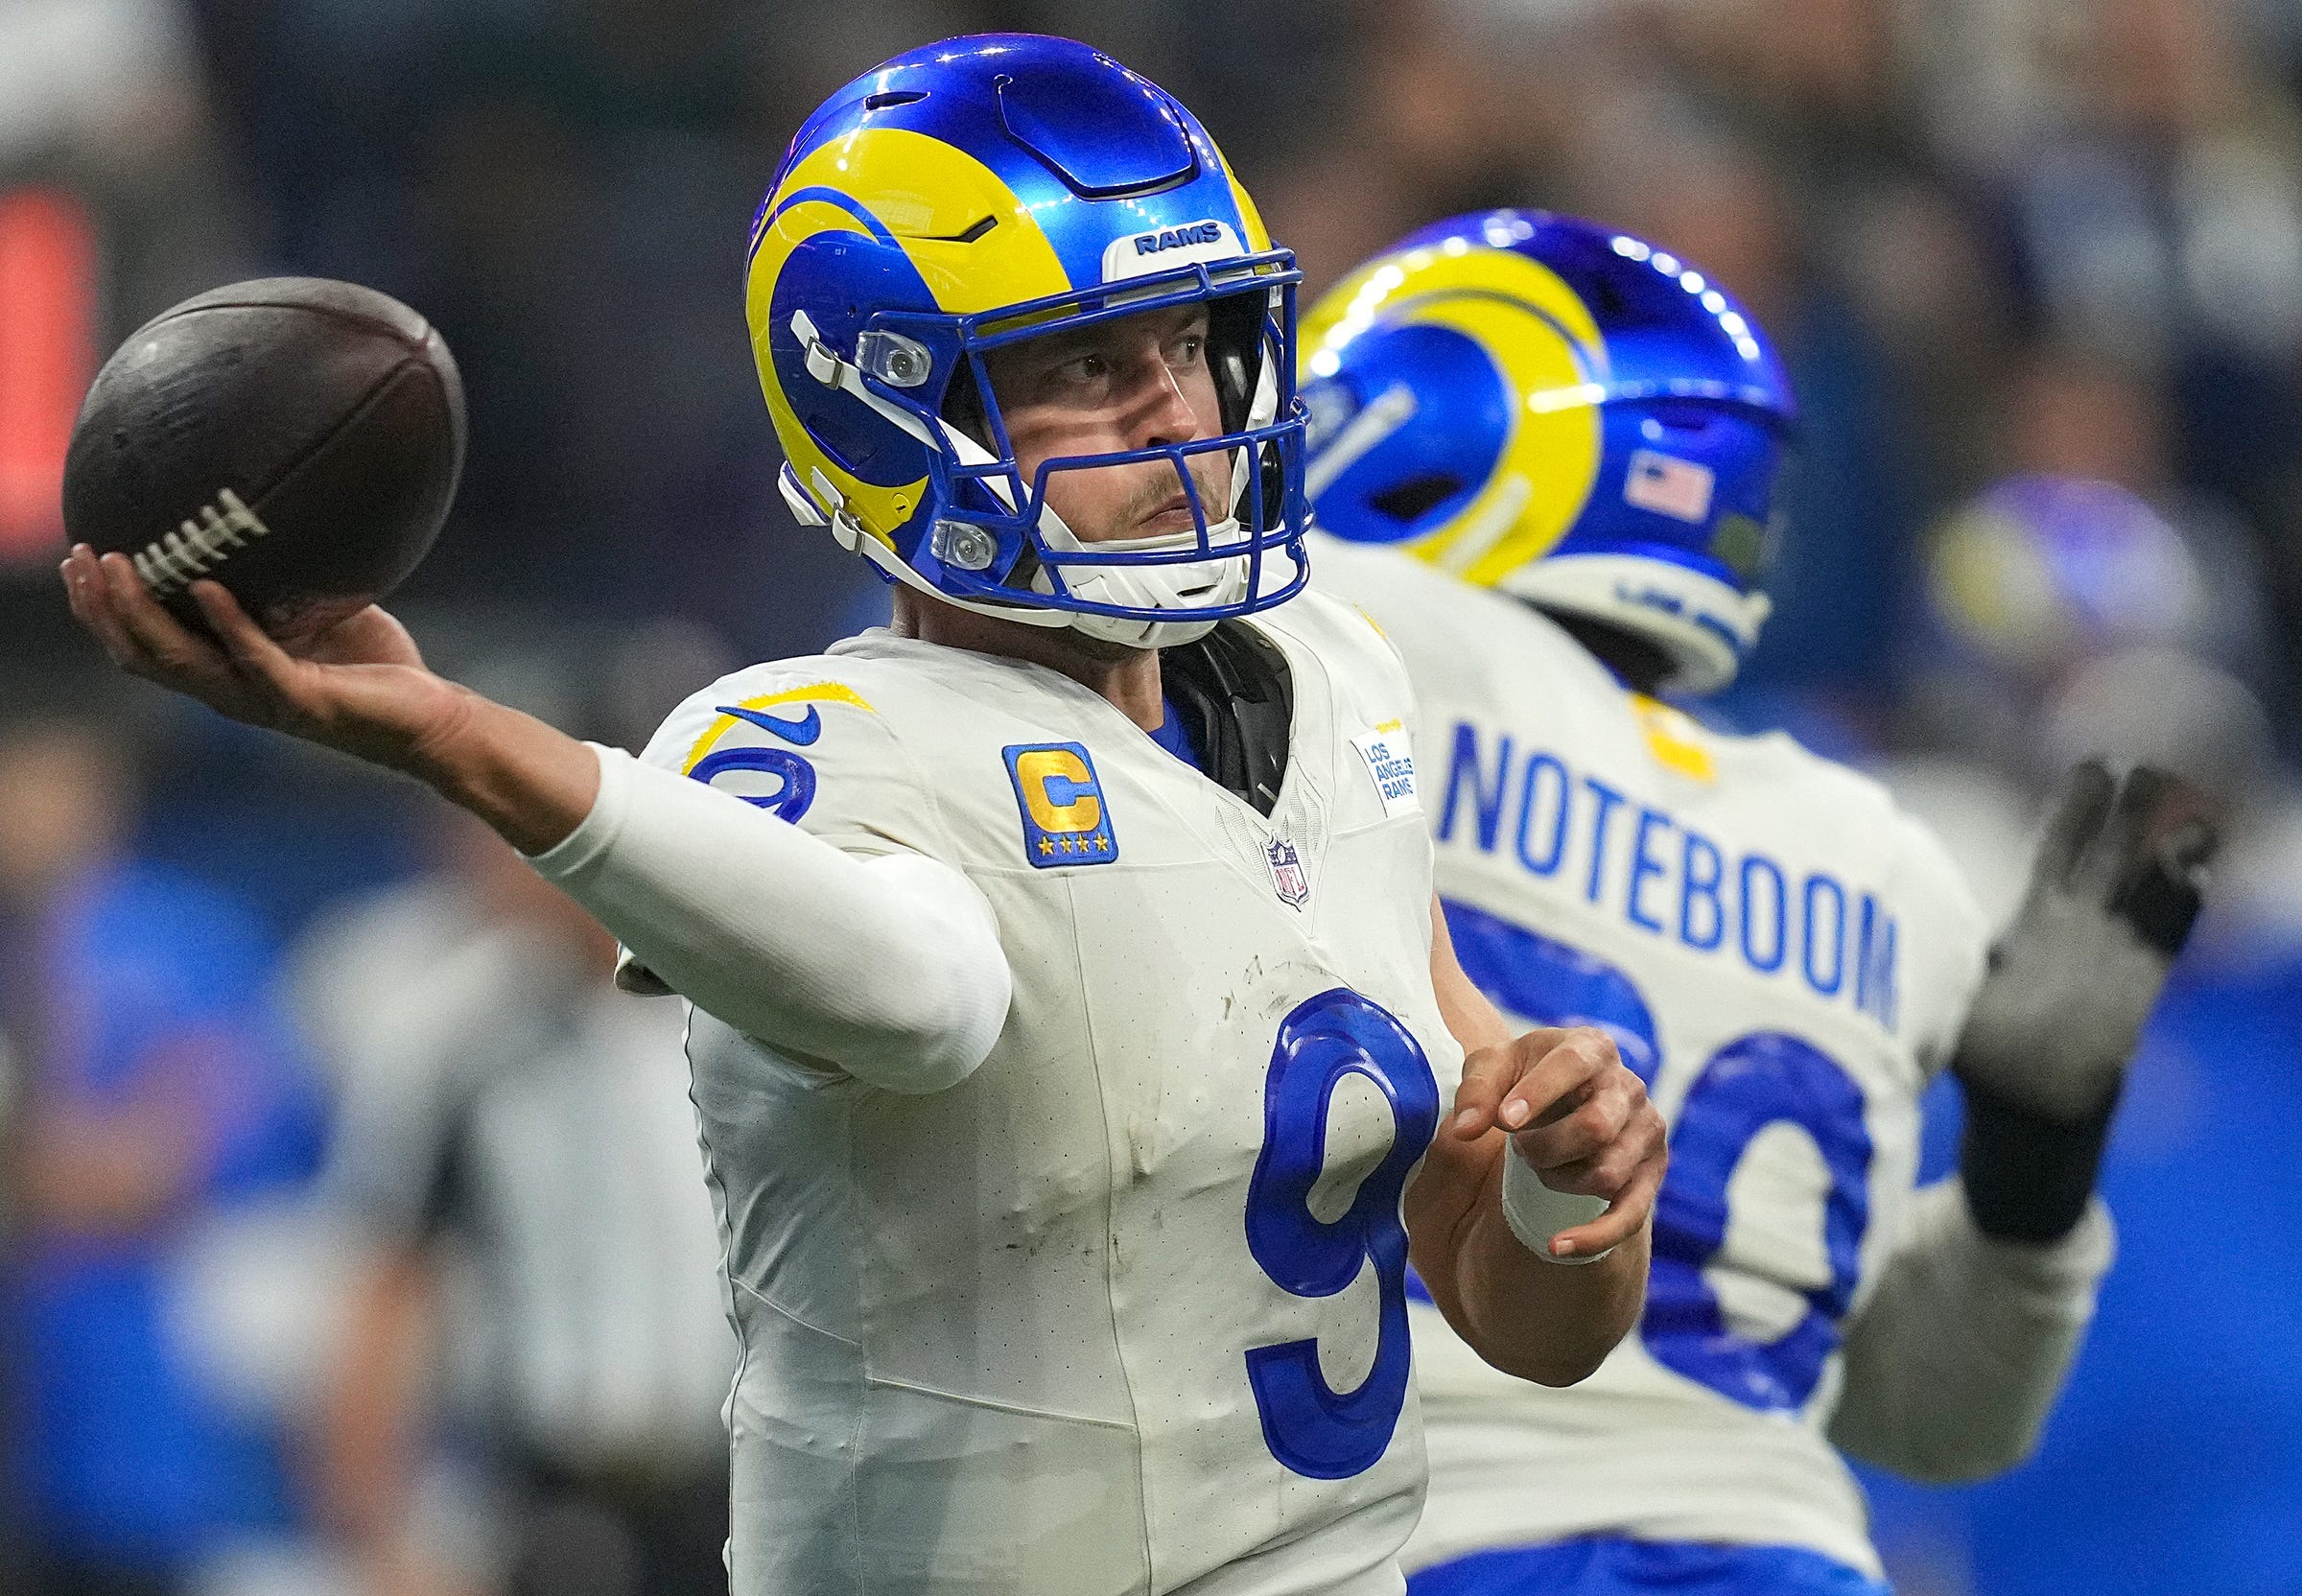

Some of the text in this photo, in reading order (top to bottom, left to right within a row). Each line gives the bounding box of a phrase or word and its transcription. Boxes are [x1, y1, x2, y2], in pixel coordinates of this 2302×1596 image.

[1134, 222, 1221, 255] RAMS
[1364, 742, 1390, 763] LOS
[1016, 749, 1101, 833] C
[1382, 777, 1414, 800] RAMS
[1275, 866, 1304, 896] NFL
[1436, 720, 1899, 1036] NOTEBOOM
[1245, 986, 1439, 1479] 9
